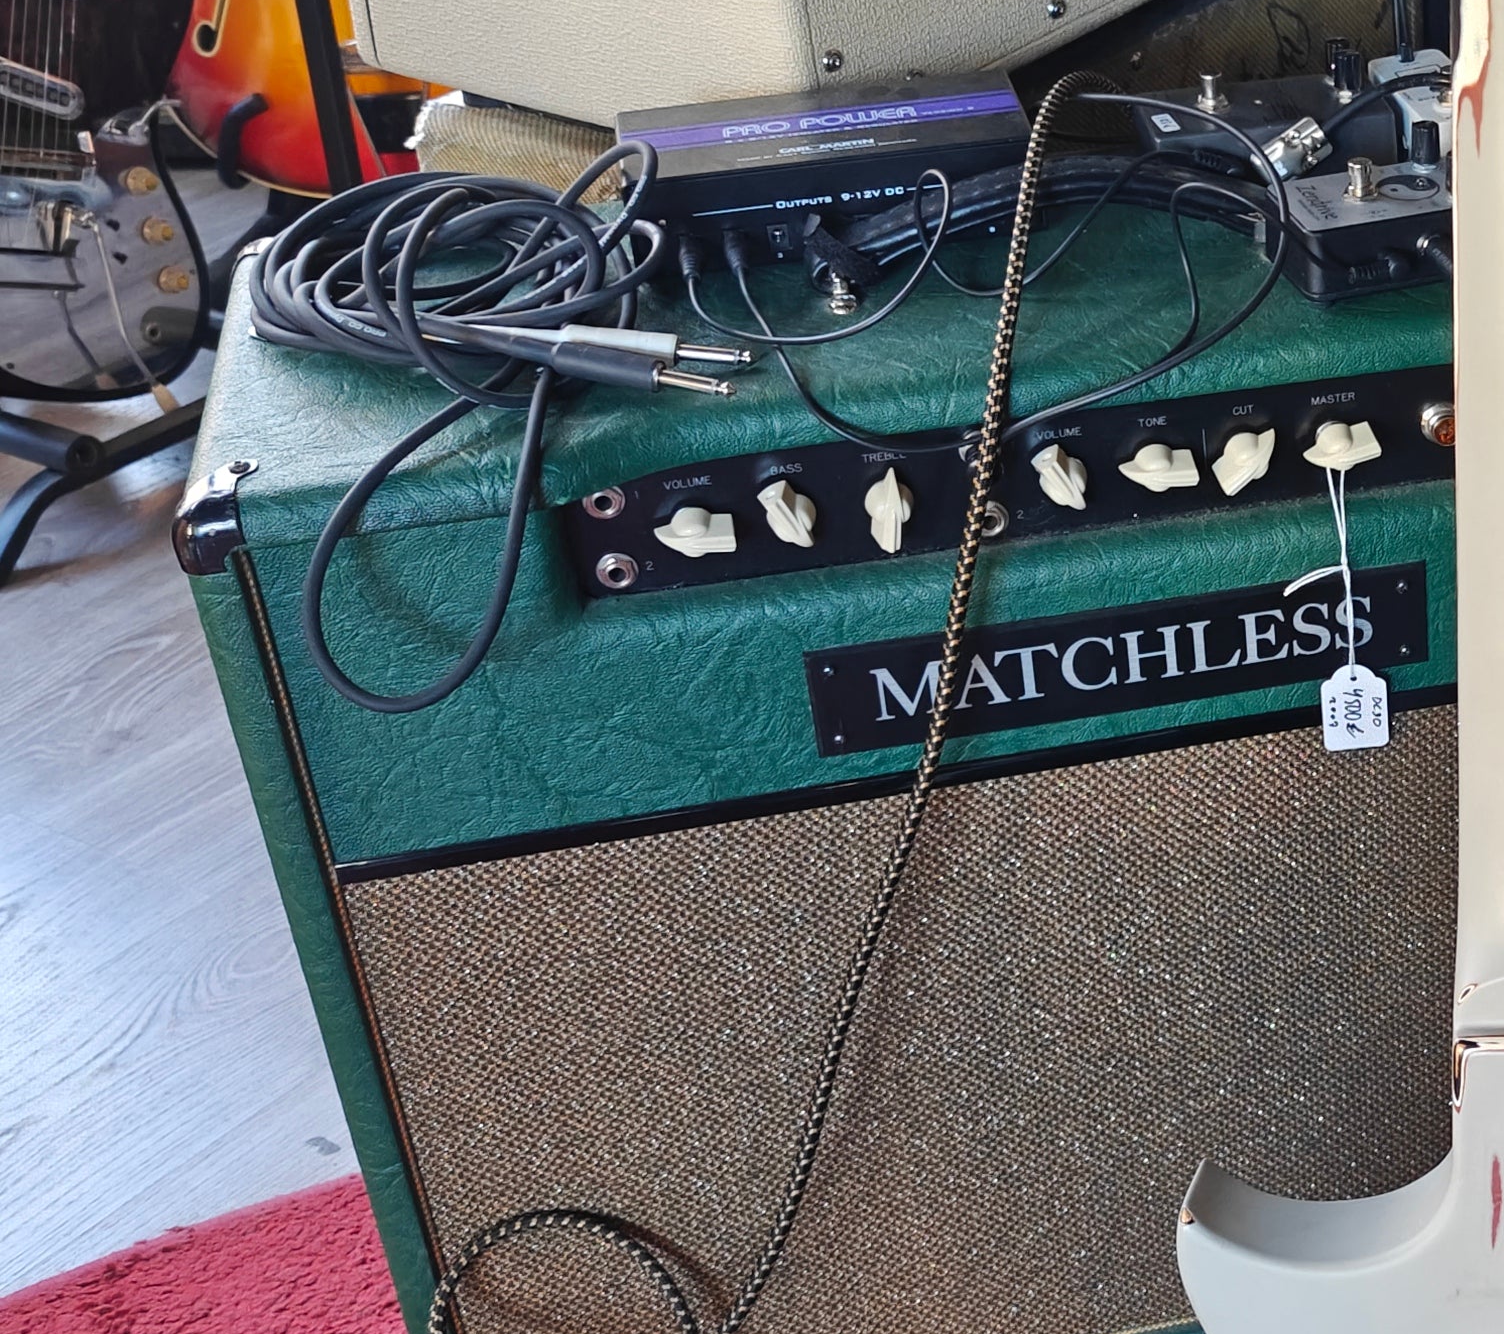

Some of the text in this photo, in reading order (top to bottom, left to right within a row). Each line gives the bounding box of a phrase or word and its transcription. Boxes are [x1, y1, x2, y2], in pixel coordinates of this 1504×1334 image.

[722, 120, 791, 139] PRO
[800, 106, 917, 131] POWER
[779, 145, 814, 154] CARL
[819, 138, 875, 149] MARTIN
[775, 186, 905, 210] OUTPUTS 9-12V DC
[1310, 391, 1357, 406] MASTER
[1232, 404, 1254, 416] CUT
[1137, 415, 1167, 428] TONE
[1035, 426, 1083, 442] VOLUME
[769, 462, 804, 476] BASS
[663, 475, 713, 491] VOLUME
[1016, 509, 1025, 520] 2
[646, 560, 655, 572] 2
[869, 595, 1375, 722] MATCHLESS
